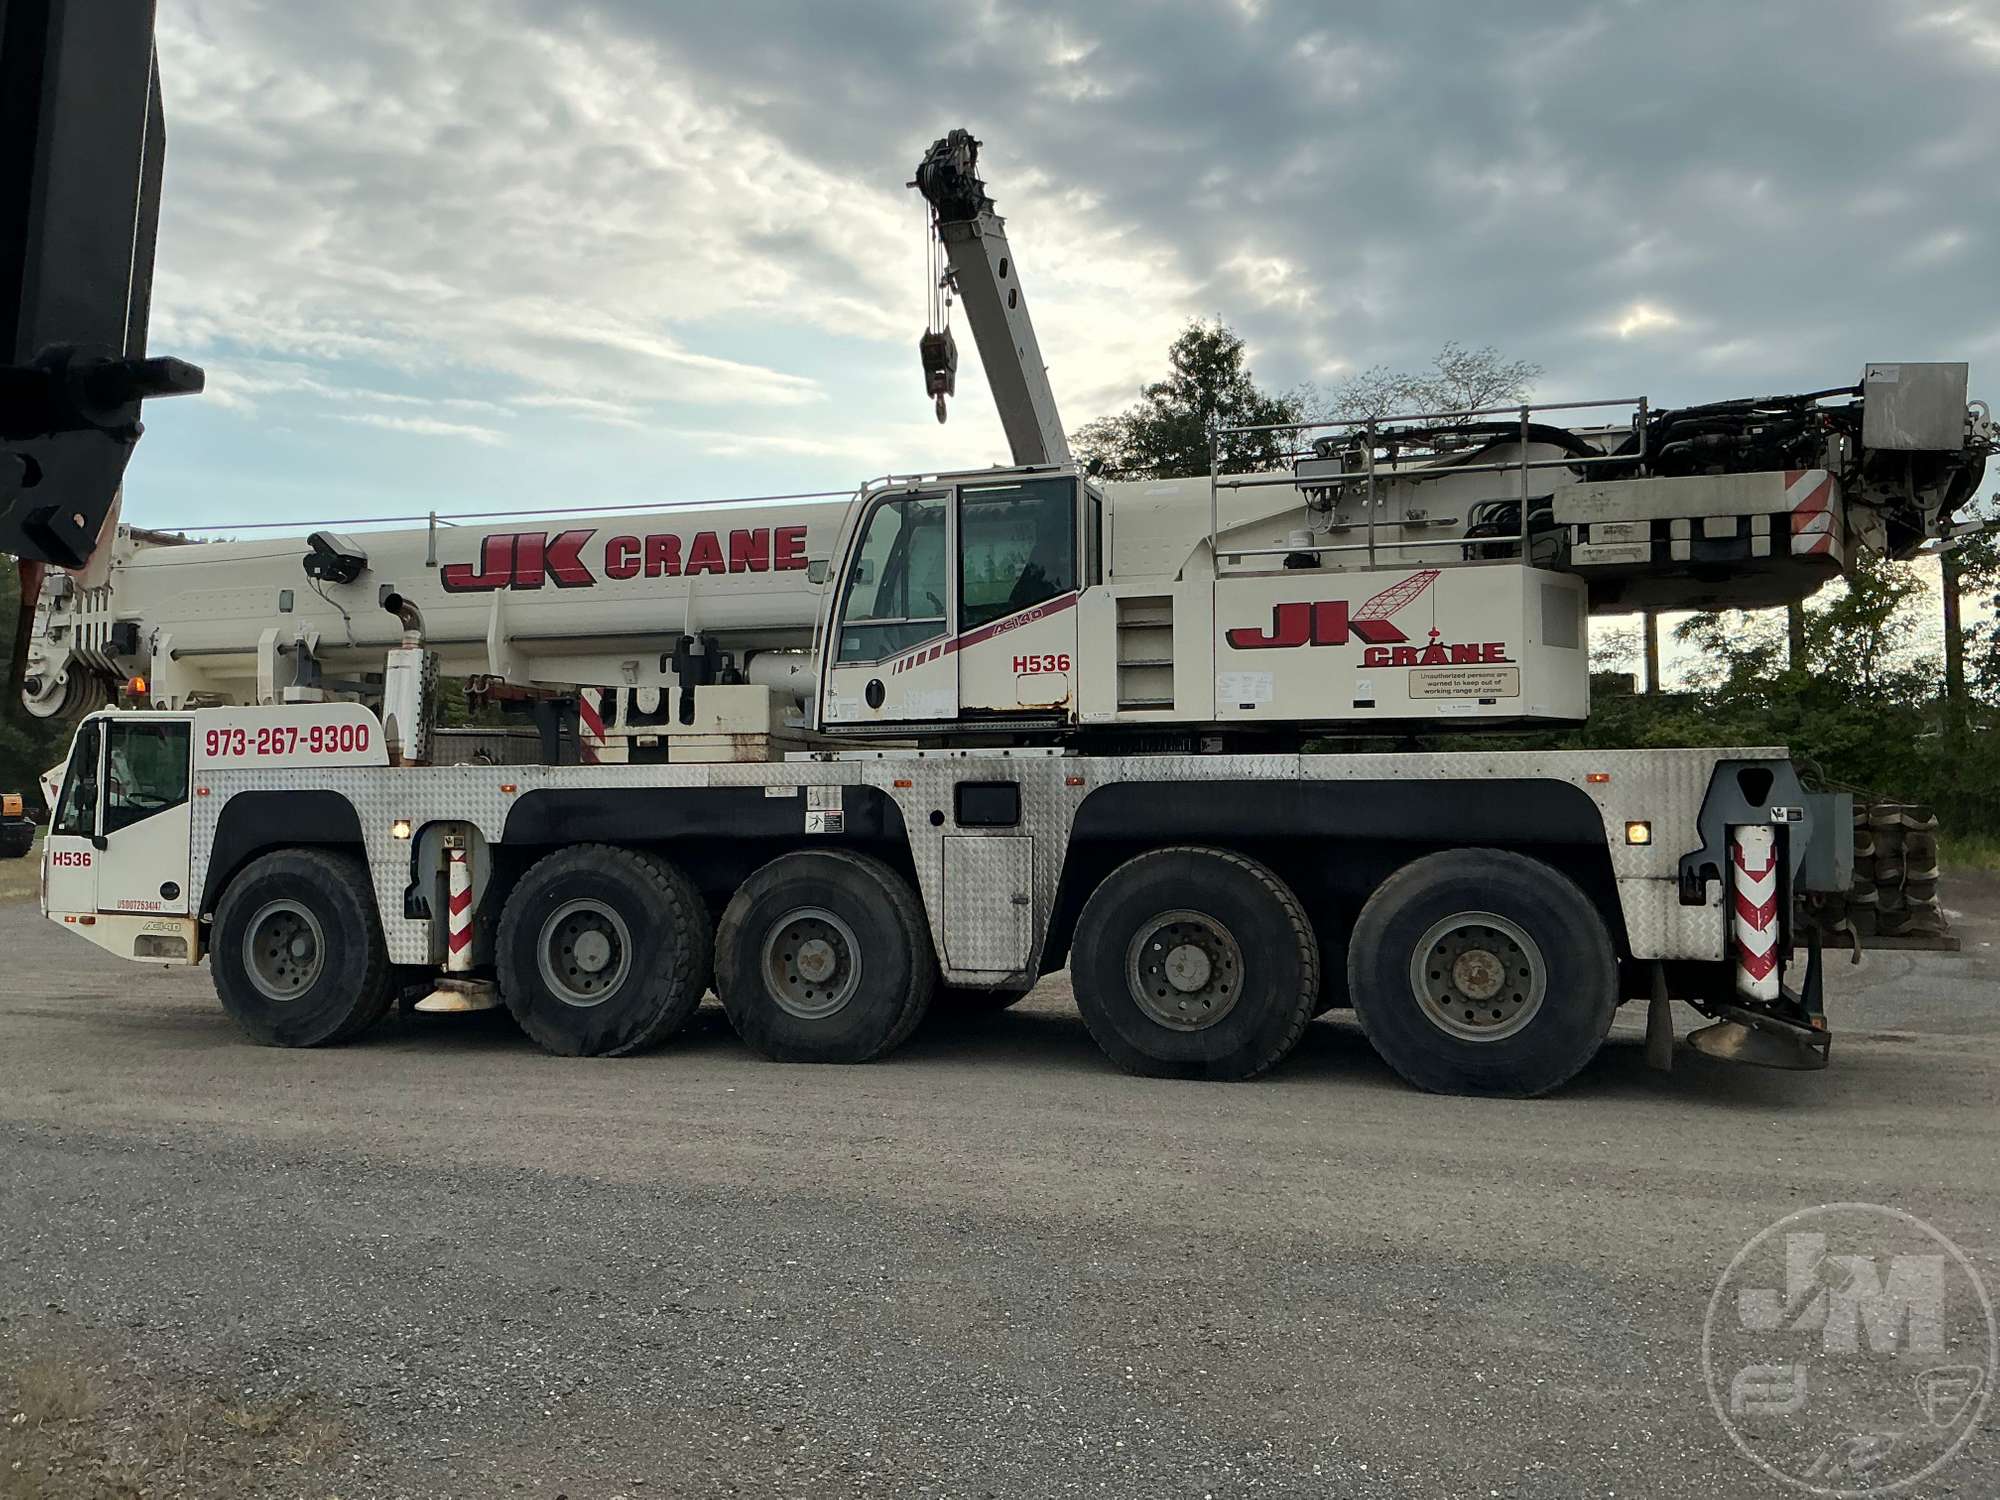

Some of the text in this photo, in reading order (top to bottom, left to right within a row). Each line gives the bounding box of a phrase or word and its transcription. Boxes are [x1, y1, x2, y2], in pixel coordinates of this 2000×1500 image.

[440, 525, 809, 593] JK CRANE
[1013, 654, 1071, 673] H536
[1363, 642, 1507, 667] CRANE
[206, 724, 370, 756] 973-267-9300
[53, 851, 92, 867] H536
